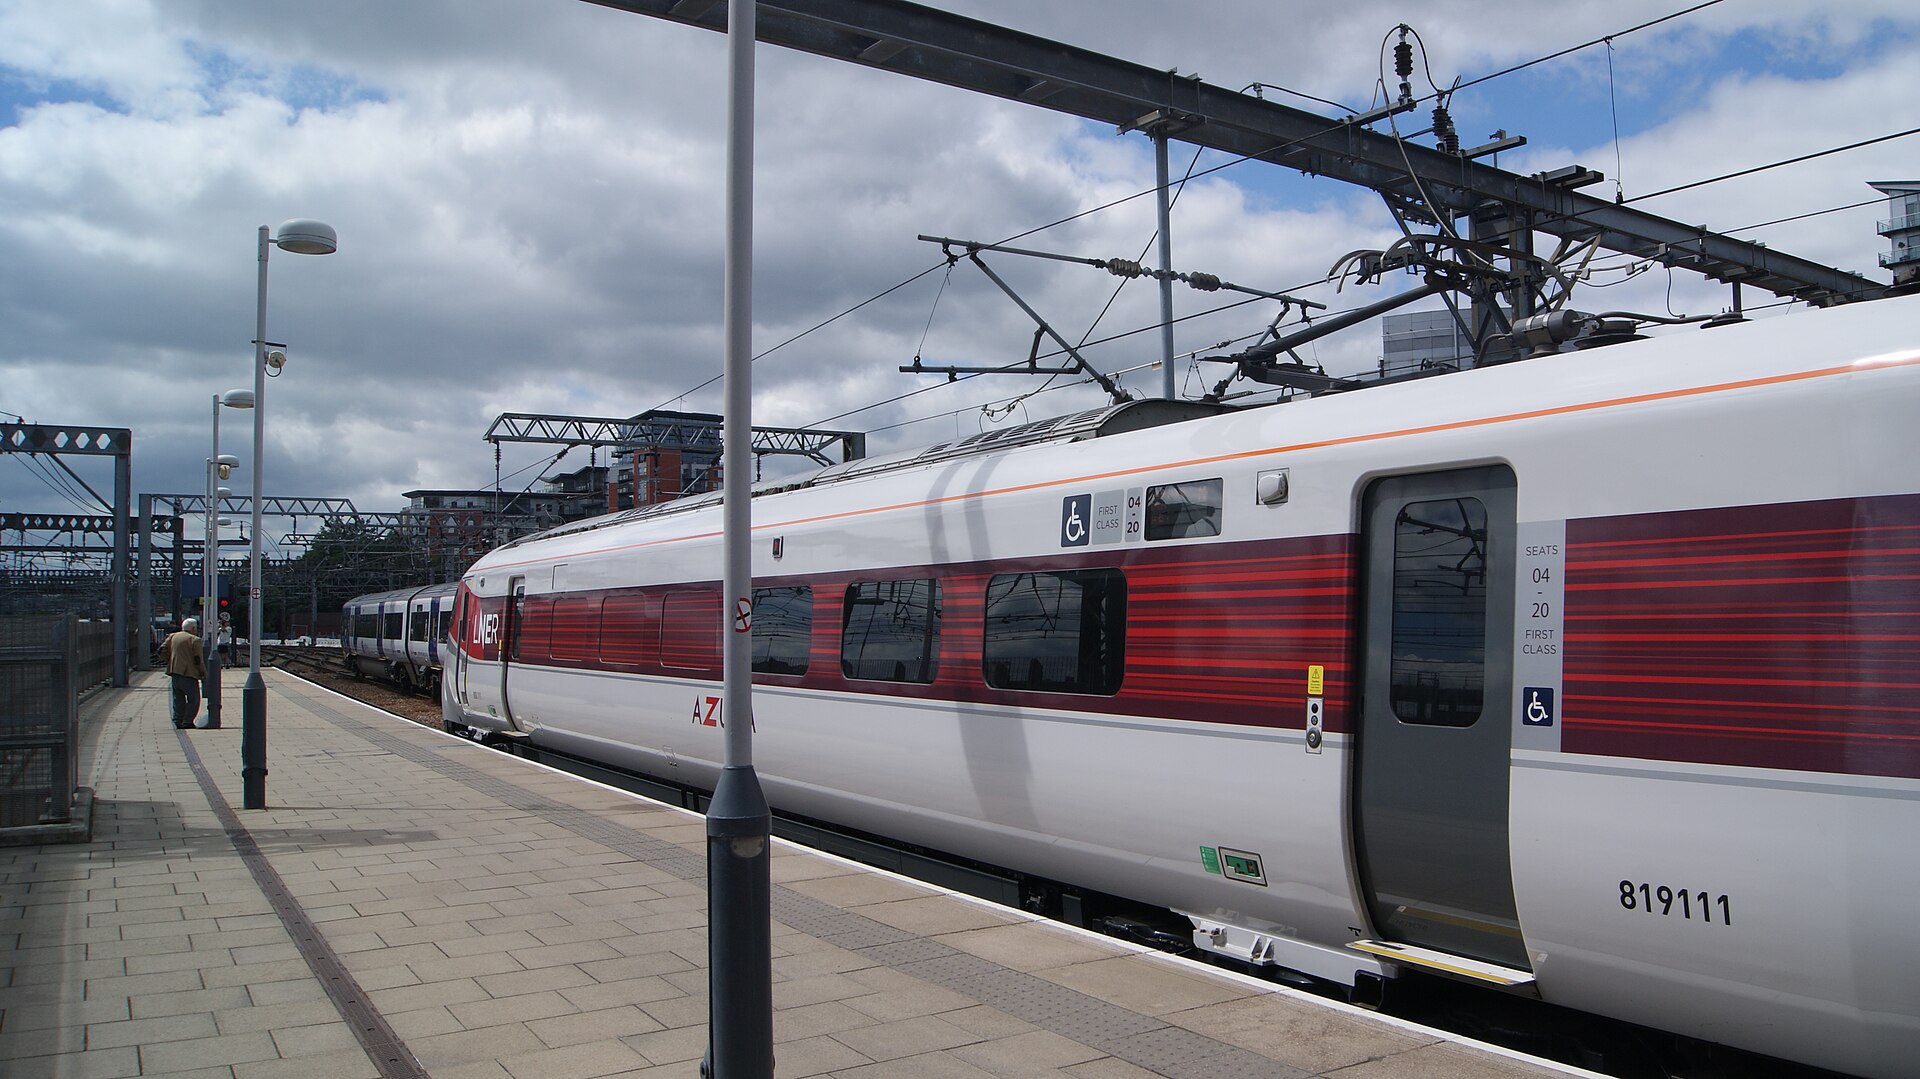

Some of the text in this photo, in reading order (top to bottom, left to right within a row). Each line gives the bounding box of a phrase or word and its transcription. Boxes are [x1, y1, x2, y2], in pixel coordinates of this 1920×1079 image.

[1128, 496, 1141, 509] 04
[1098, 505, 1118, 516] FIRST
[1096, 518, 1119, 530] CLASS
[1127, 521, 1139, 533] 20
[1525, 545, 1558, 556] SEATS
[1532, 568, 1550, 583] 04
[1531, 603, 1549, 618] 20
[473, 608, 499, 650] LNER
[1525, 630, 1554, 639] FIRST
[1522, 645, 1557, 655] CLASS
[1619, 880, 1731, 926] 819111
